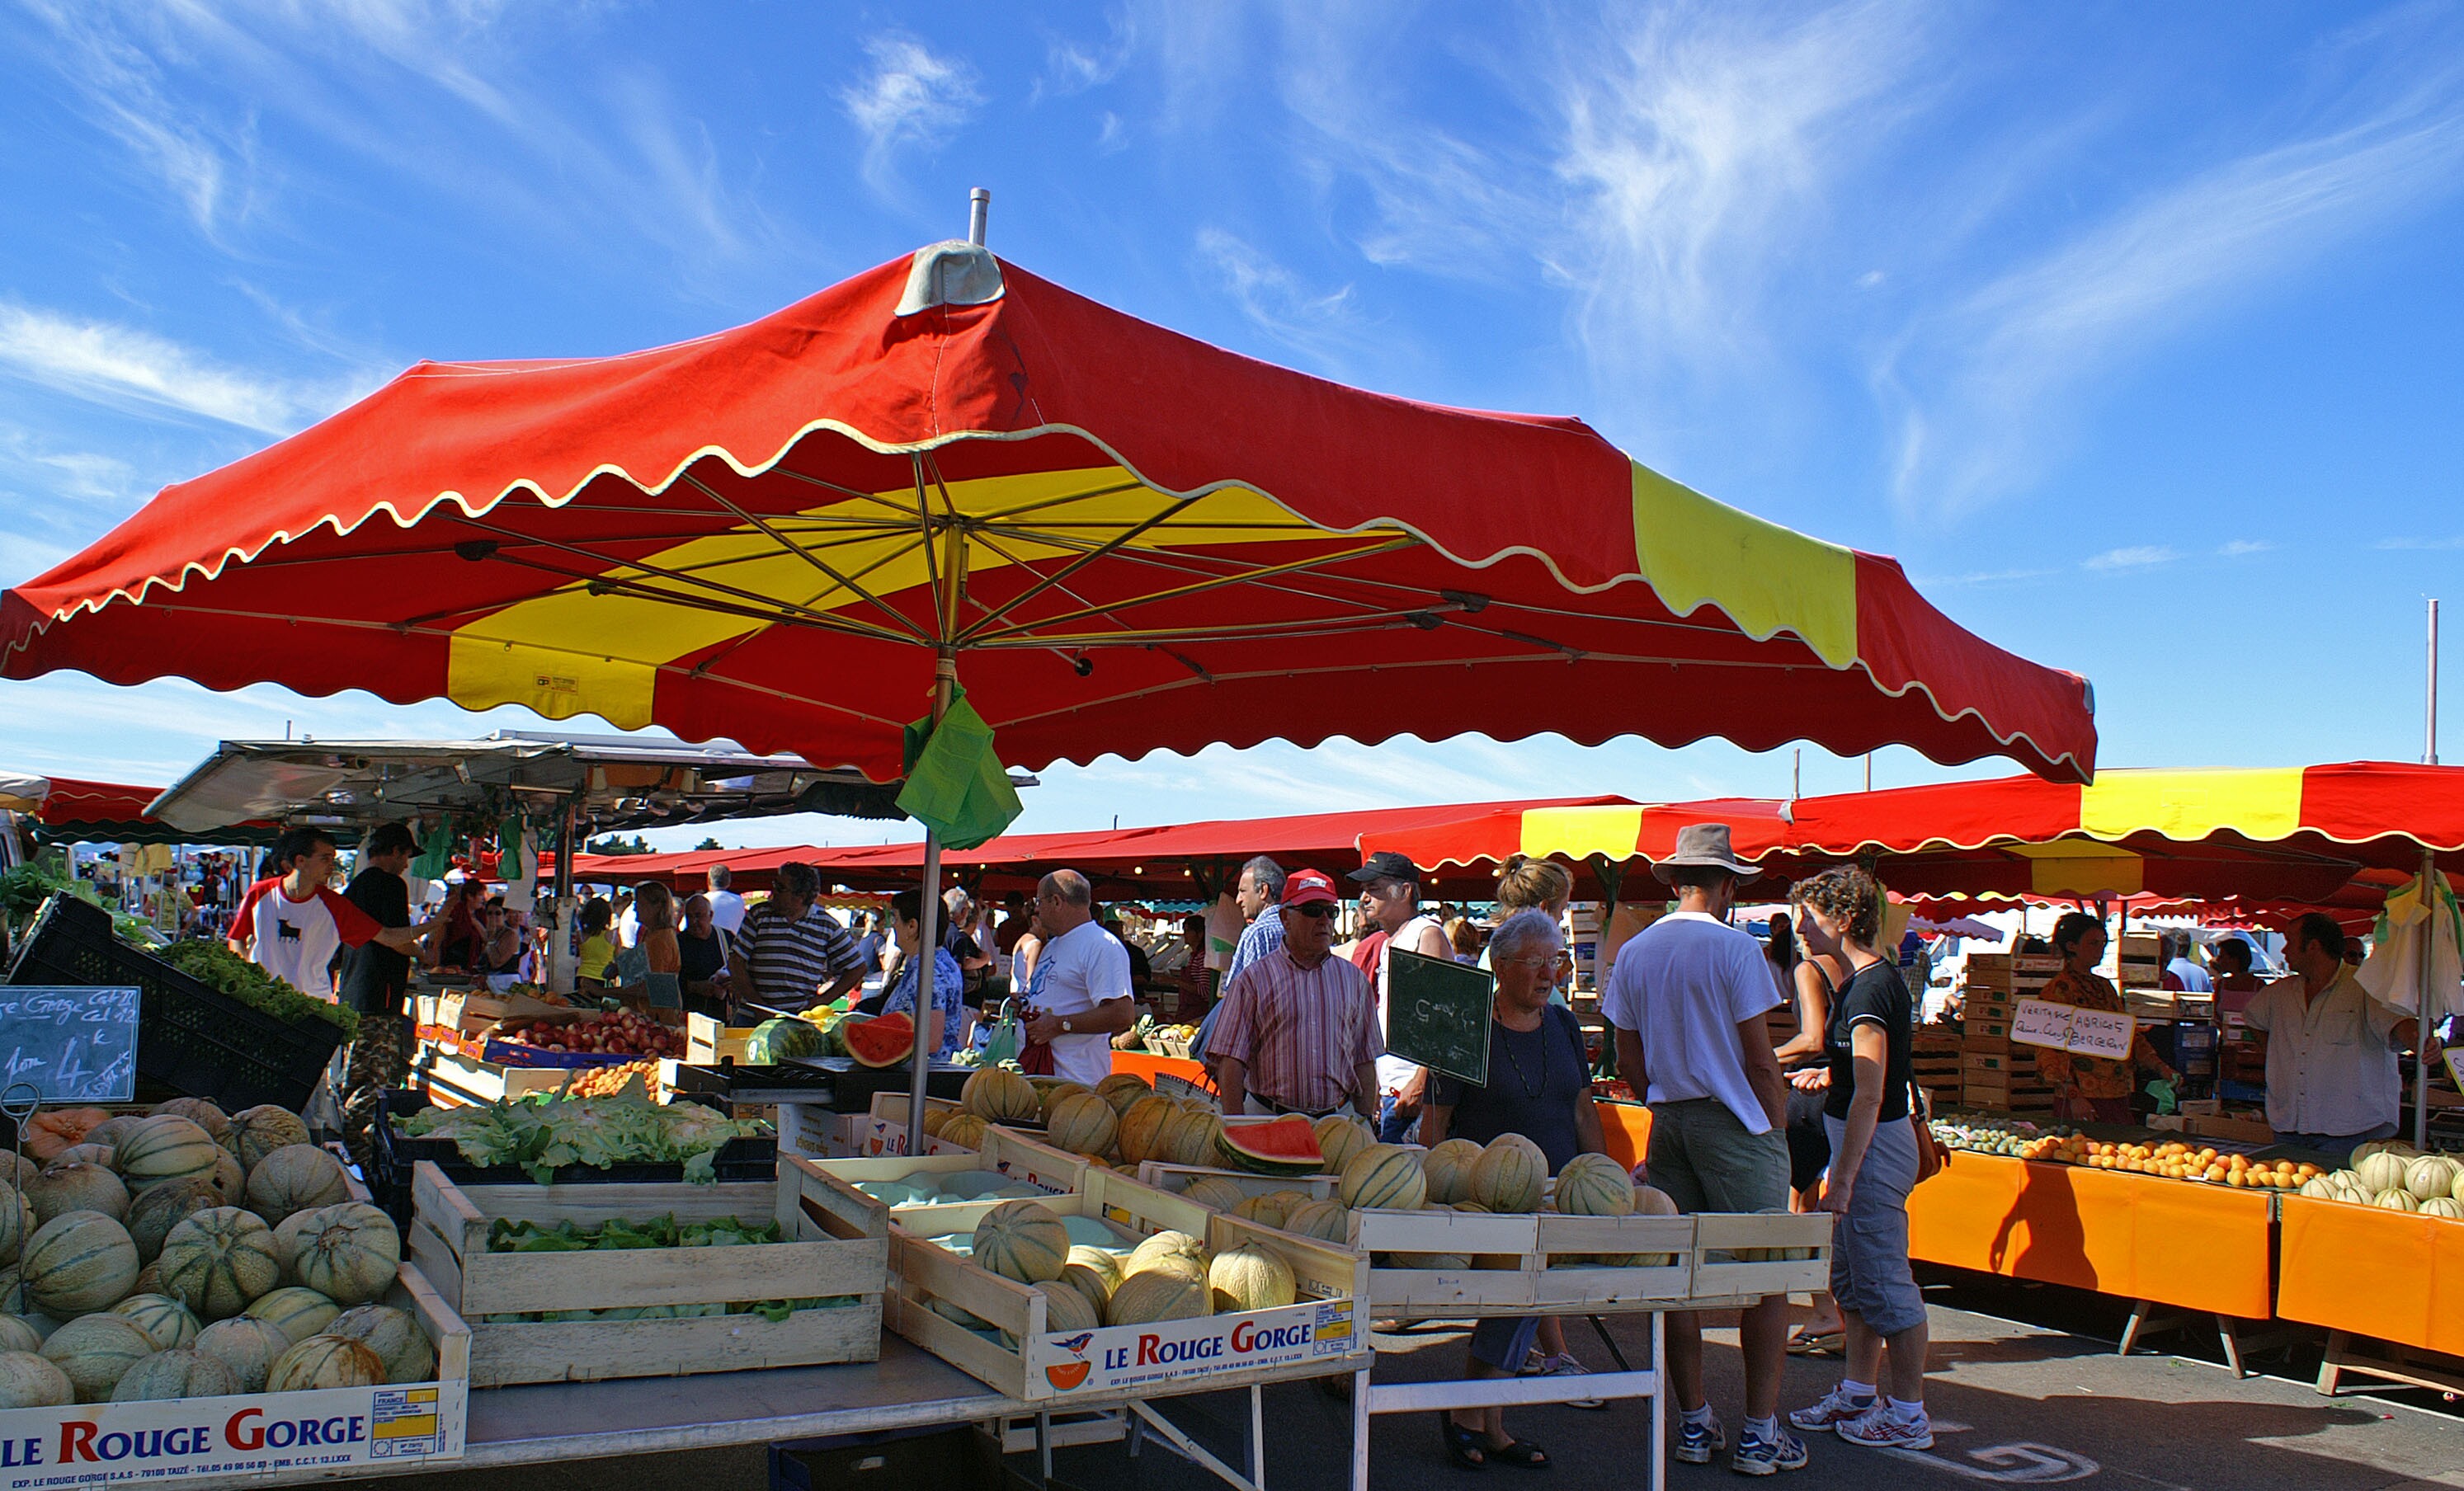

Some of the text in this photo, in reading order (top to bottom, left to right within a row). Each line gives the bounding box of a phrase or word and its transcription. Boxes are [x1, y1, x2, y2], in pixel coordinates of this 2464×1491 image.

[55, 1037, 95, 1088] 4
[1104, 1320, 1312, 1371] LE ROUGE GORGE
[1, 1408, 367, 1468] LE ROUGE GORGE
[12, 1479, 31, 1489] EXP.
[34, 1479, 44, 1487] LE
[46, 1477, 77, 1486] ROUGE
